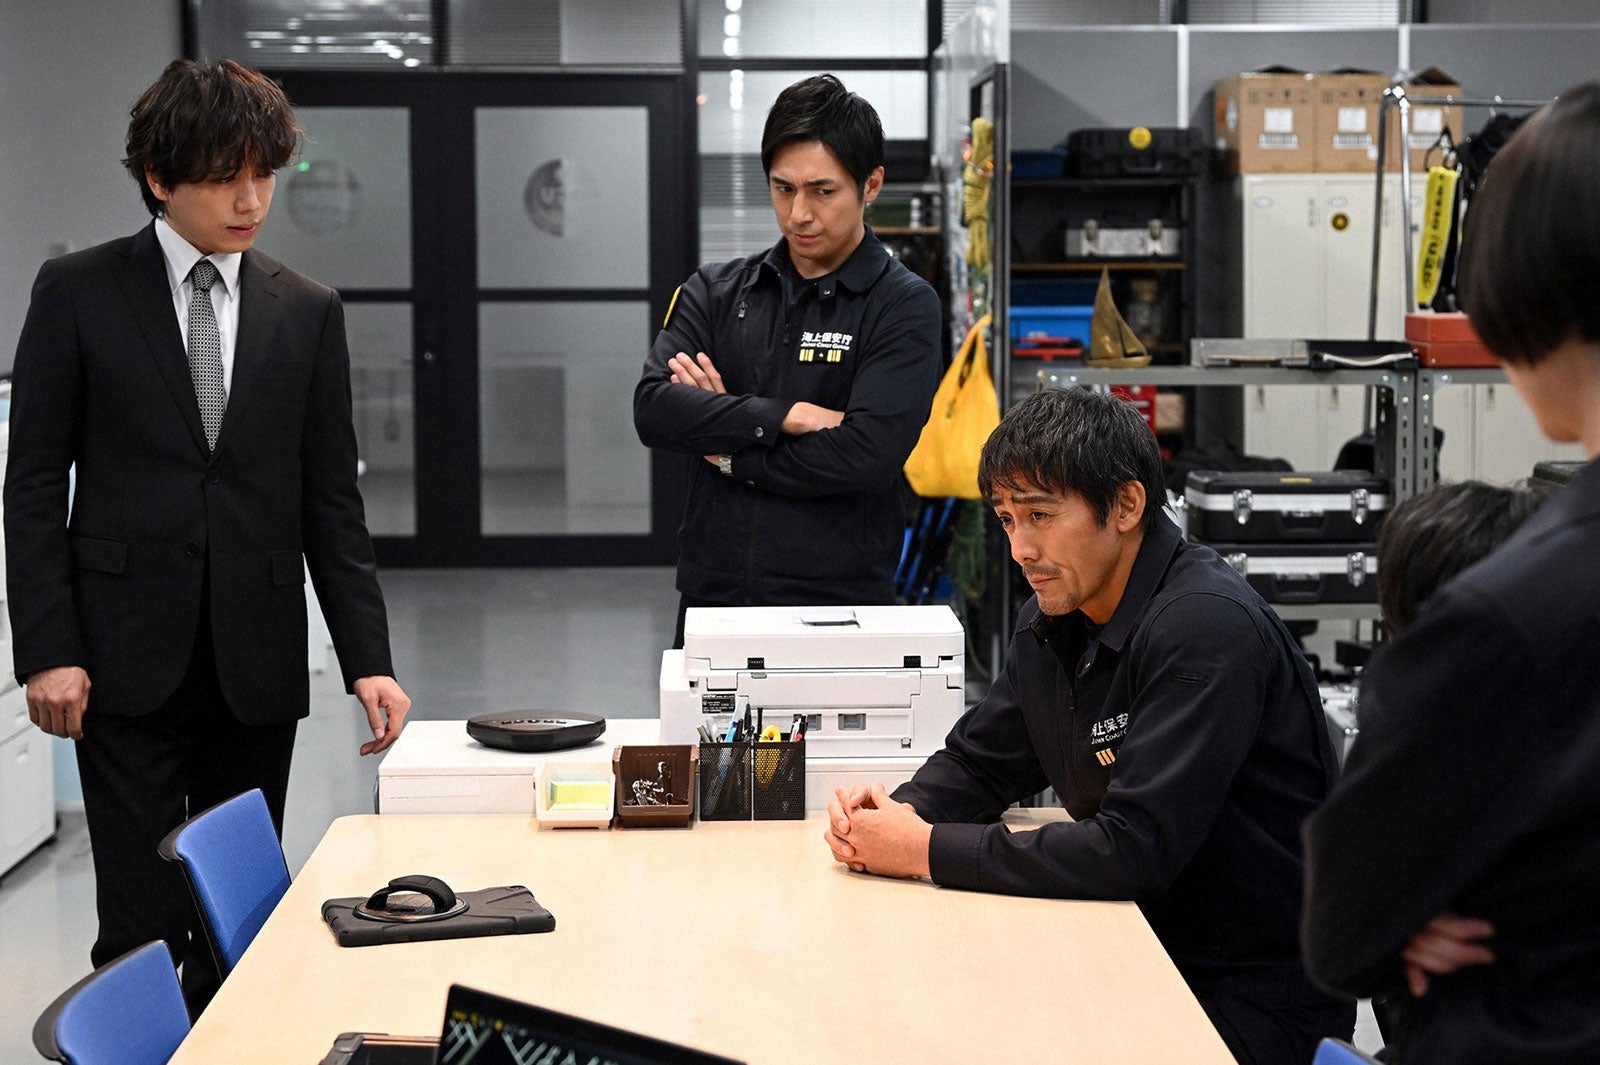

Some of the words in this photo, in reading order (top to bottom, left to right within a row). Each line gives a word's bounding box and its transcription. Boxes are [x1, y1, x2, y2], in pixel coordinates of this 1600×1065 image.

[801, 331, 853, 346] 海上保安庁
